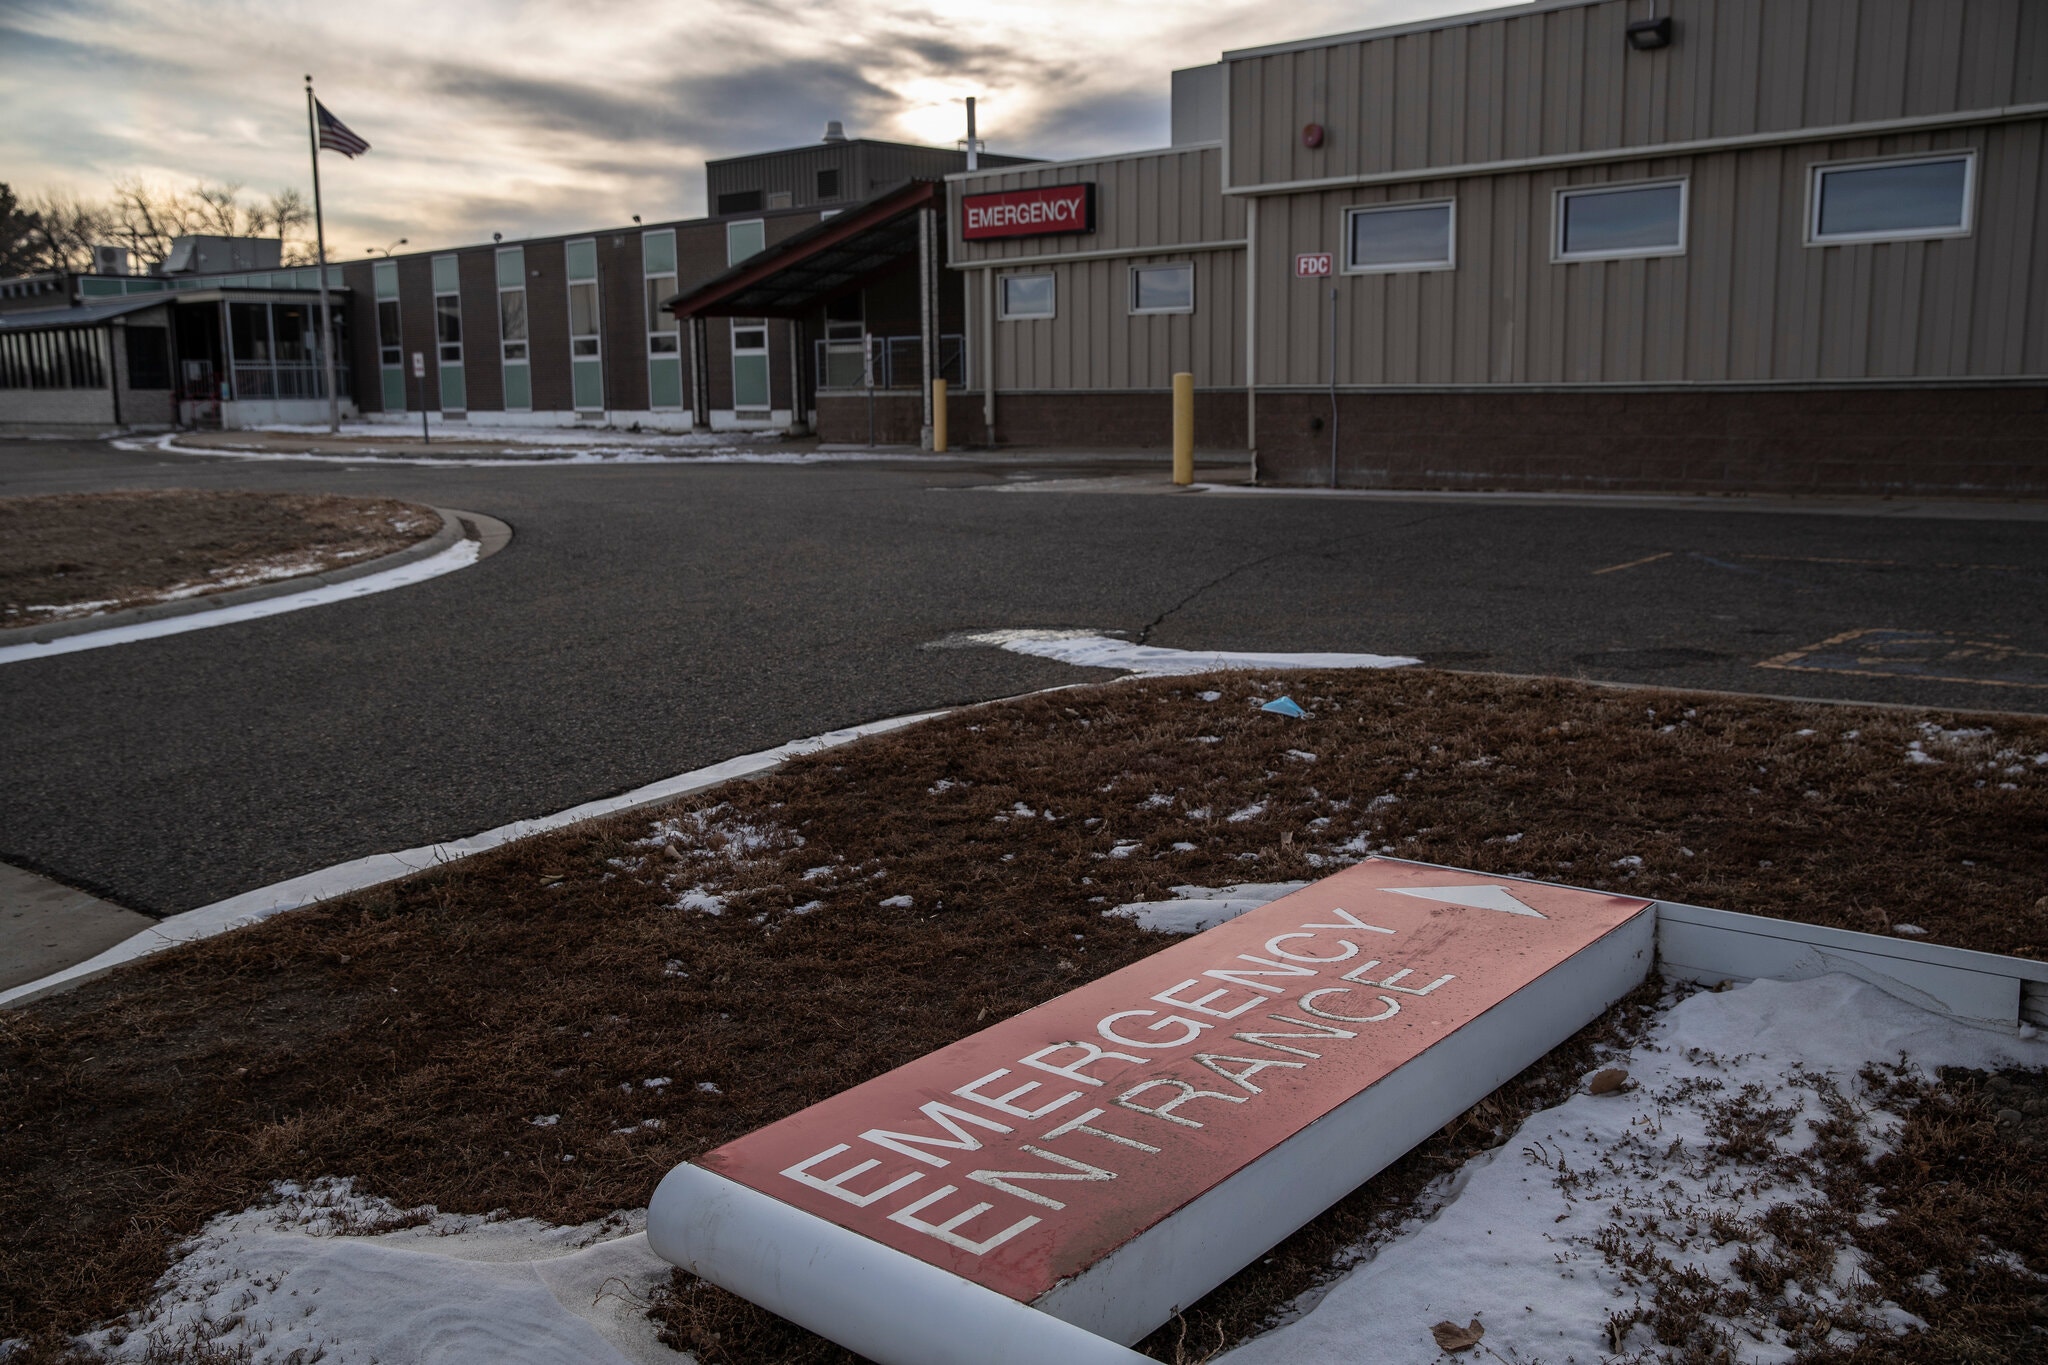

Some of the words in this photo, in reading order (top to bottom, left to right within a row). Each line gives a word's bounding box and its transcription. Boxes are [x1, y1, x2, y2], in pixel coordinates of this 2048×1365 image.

[968, 199, 1081, 229] EMERGENCY
[1300, 257, 1328, 274] FDC
[779, 907, 1395, 1208] EMERGENCY
[886, 959, 1455, 1256] ENTRANCE
